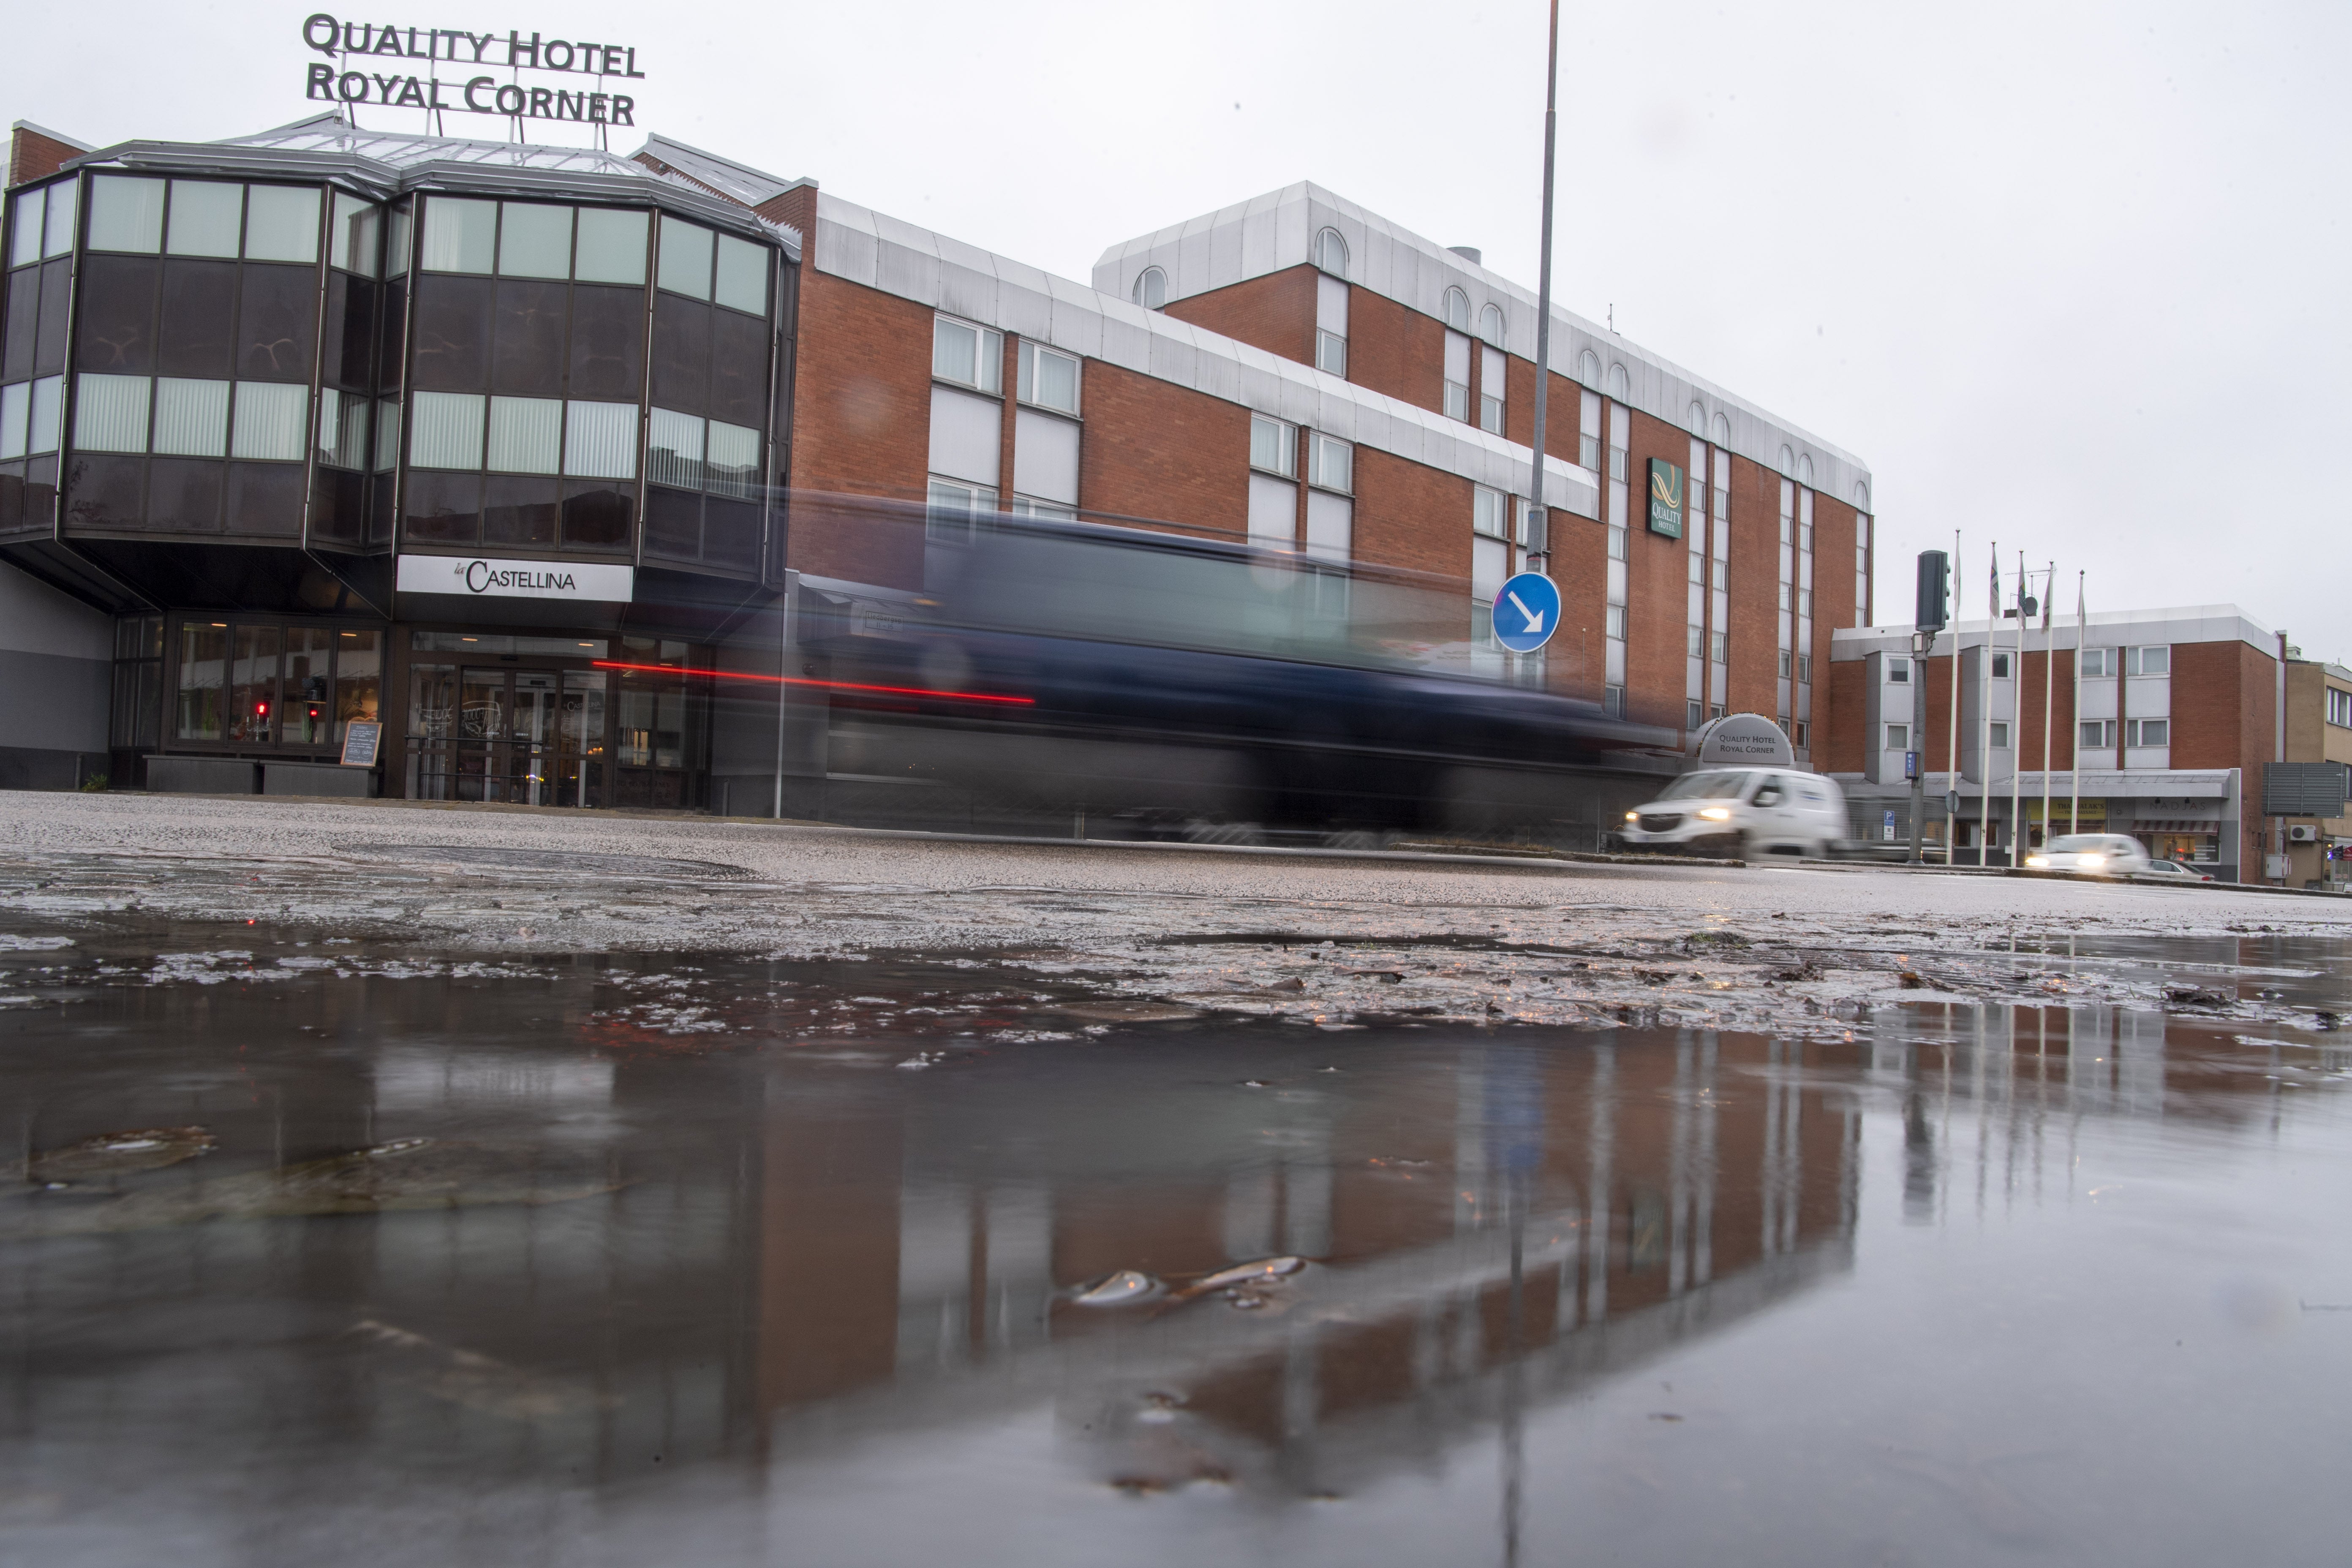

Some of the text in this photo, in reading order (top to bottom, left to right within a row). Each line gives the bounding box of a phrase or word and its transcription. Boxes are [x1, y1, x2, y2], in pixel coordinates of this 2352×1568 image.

[302, 13, 645, 79] QUALITY HOTEL
[306, 62, 634, 126] ROYAL CORNER
[1652, 502, 1681, 525] QUALITY
[1658, 520, 1675, 532] HOTEL
[454, 561, 576, 593] la CASTELLINA
[1719, 735, 1750, 743] QUALITY
[1746, 746, 1774, 754] CORNER
[2149, 802, 2206, 811] NADJAS
